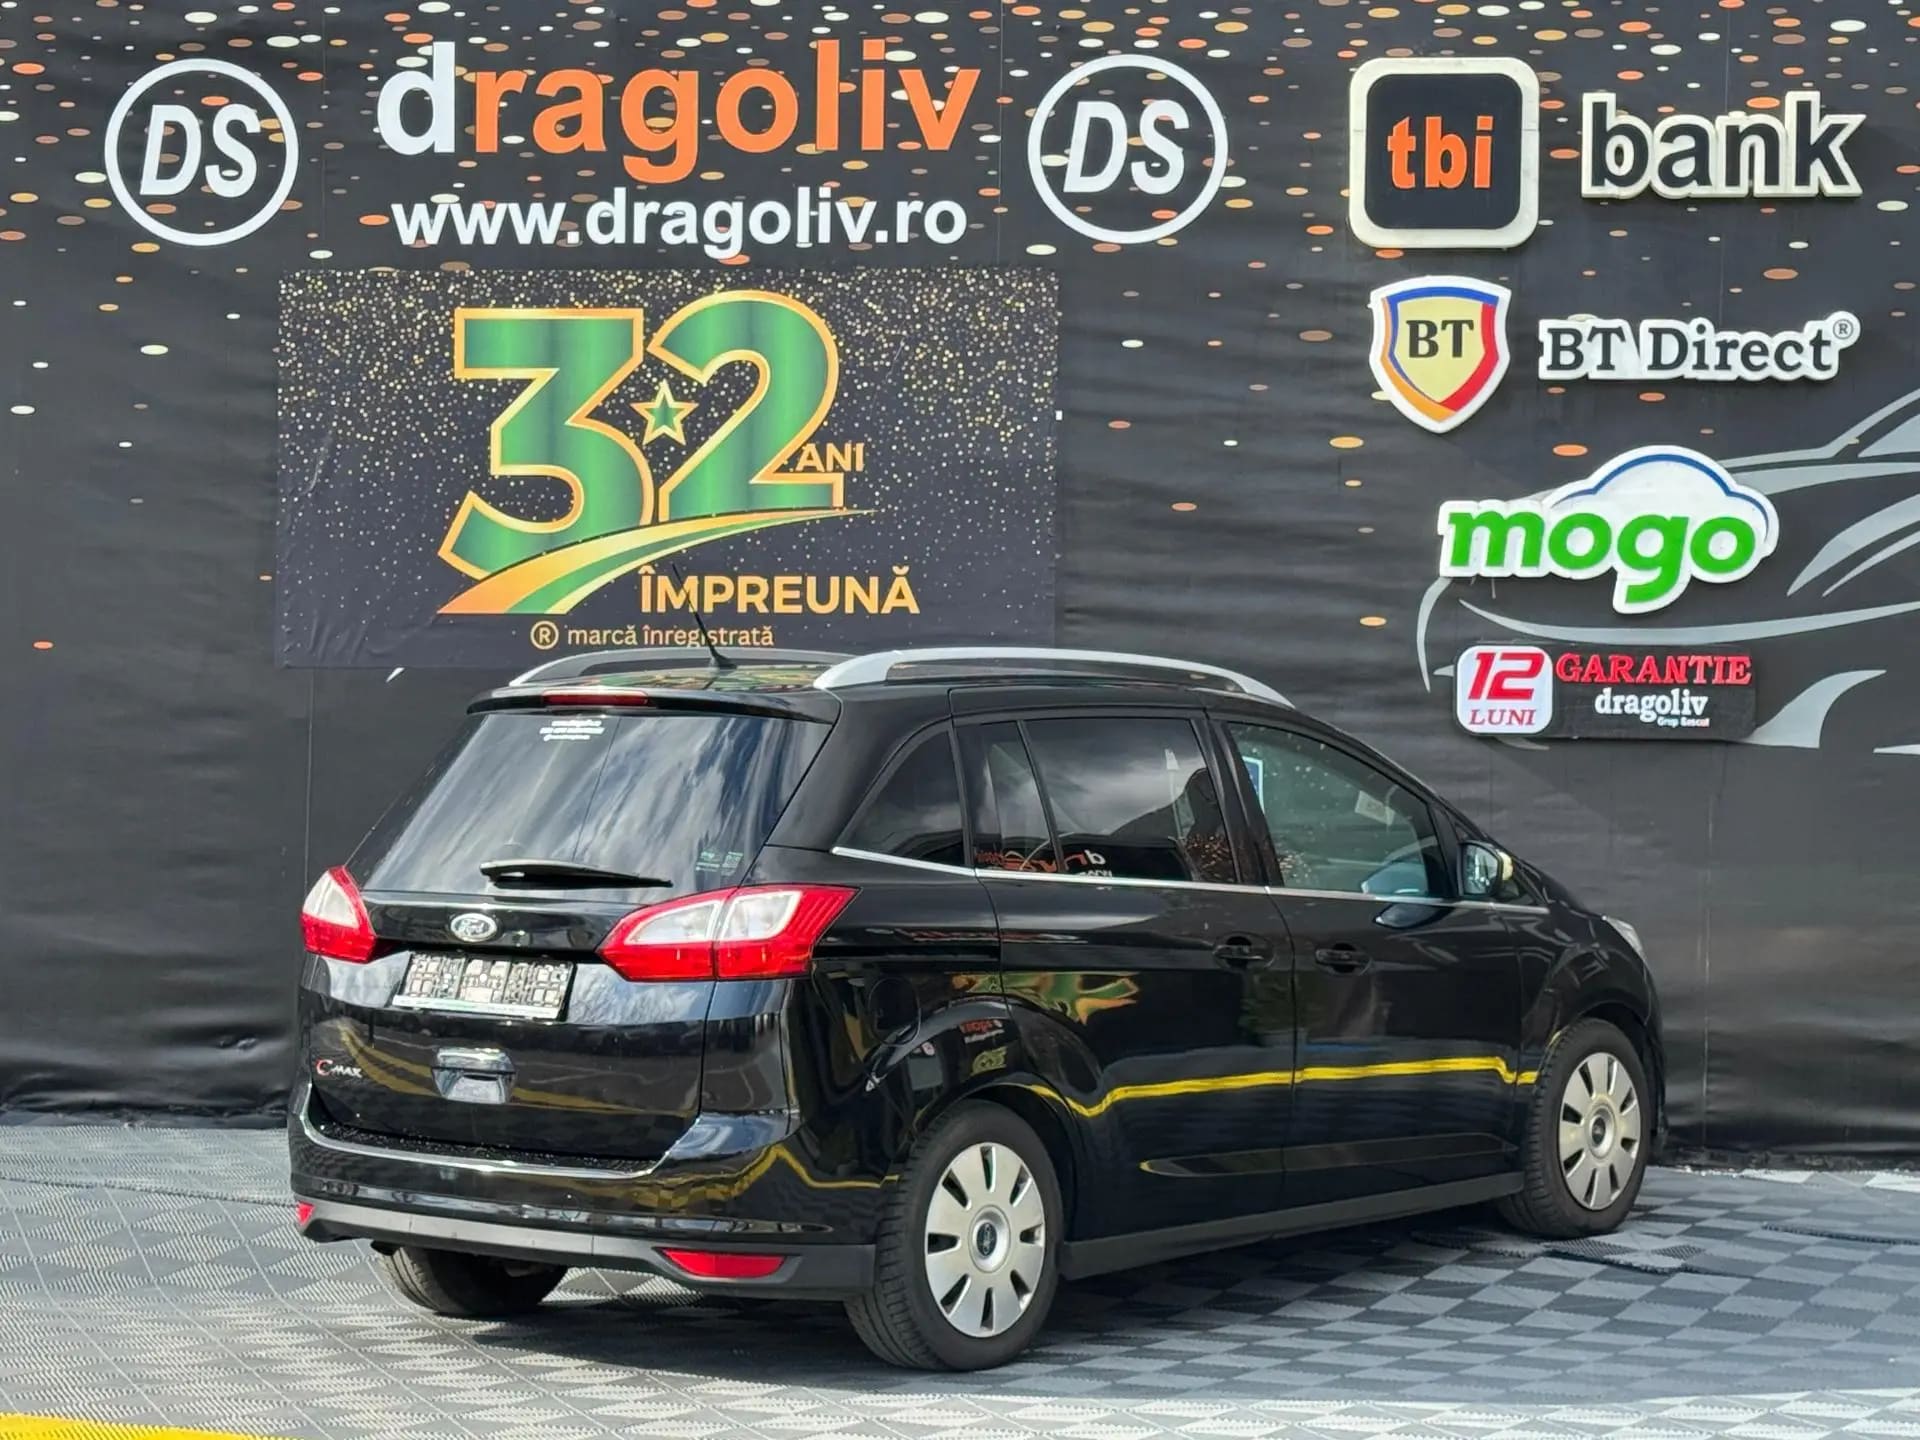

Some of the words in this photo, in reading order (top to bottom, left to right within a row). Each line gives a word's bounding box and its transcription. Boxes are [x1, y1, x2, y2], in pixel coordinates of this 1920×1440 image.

[377, 39, 981, 183] dragoliv
[139, 103, 262, 198] DS
[1063, 99, 1190, 195] DS
[1387, 115, 1495, 190] tbi
[1588, 97, 1859, 191] bank
[392, 186, 967, 260] www.dragoliv.ro
[1405, 318, 1475, 359] BT
[1546, 325, 1626, 372] BT
[438, 289, 840, 582] 32
[795, 442, 866, 473] ANI
[1447, 509, 1757, 604] mogo
[638, 564, 921, 616] ÎMPREUNĂ
[567, 624, 638, 647] marcă
[1467, 651, 1546, 701] 12
[1555, 651, 1752, 686] GARANTIE
[1468, 708, 1537, 727] LUNI
[1594, 686, 1709, 723] dragoliv
